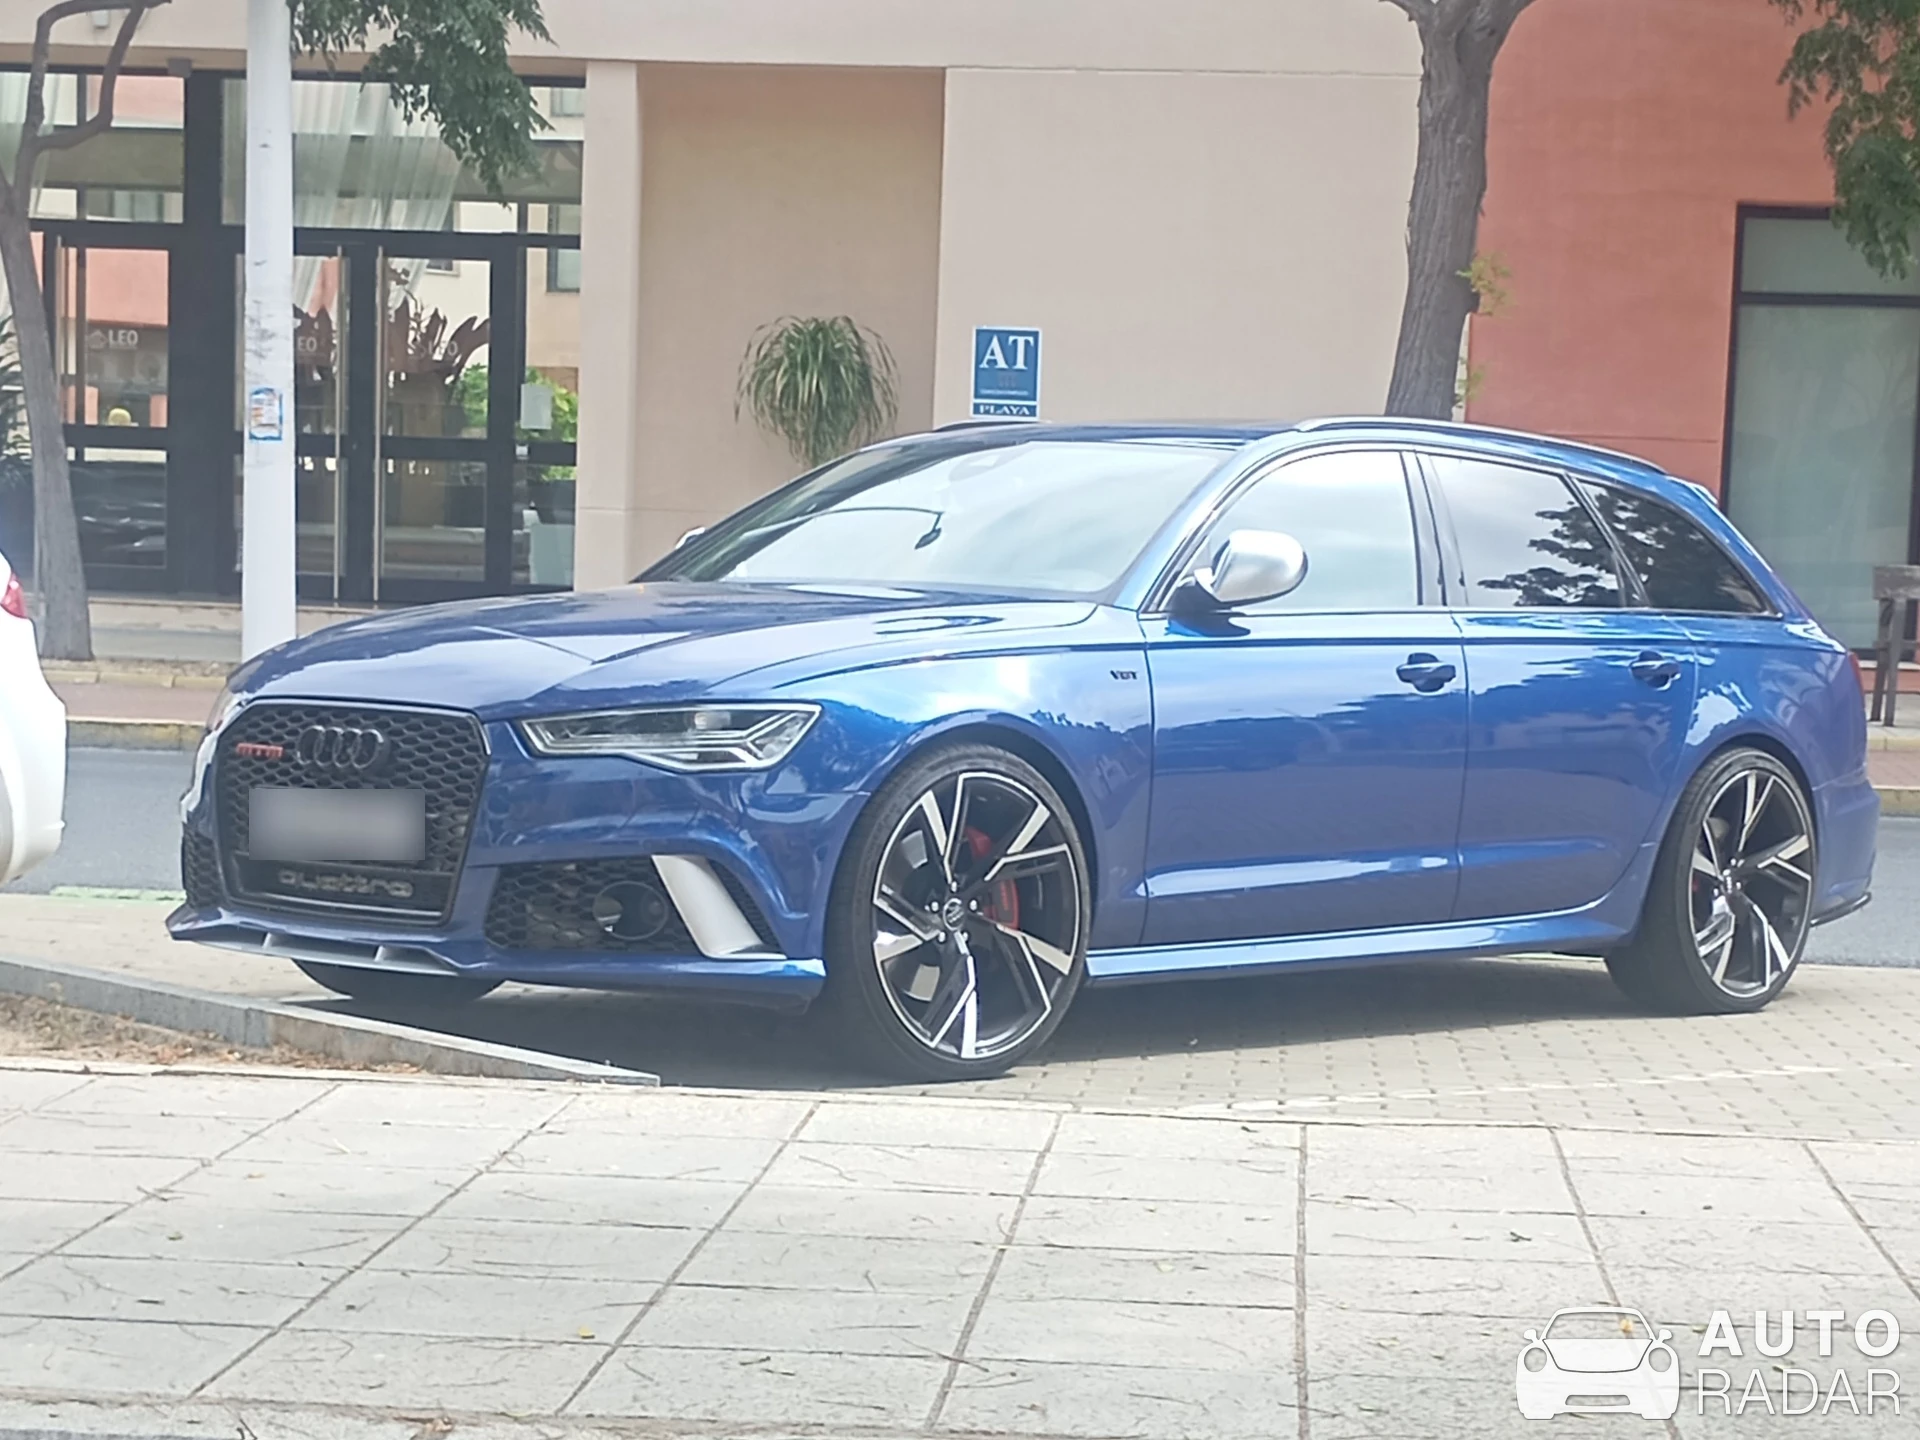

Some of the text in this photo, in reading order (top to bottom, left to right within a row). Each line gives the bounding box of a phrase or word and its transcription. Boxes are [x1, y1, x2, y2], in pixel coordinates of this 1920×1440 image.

[108, 329, 139, 346] LEO
[979, 334, 1034, 370] AT
[979, 404, 1030, 415] PLAYA
